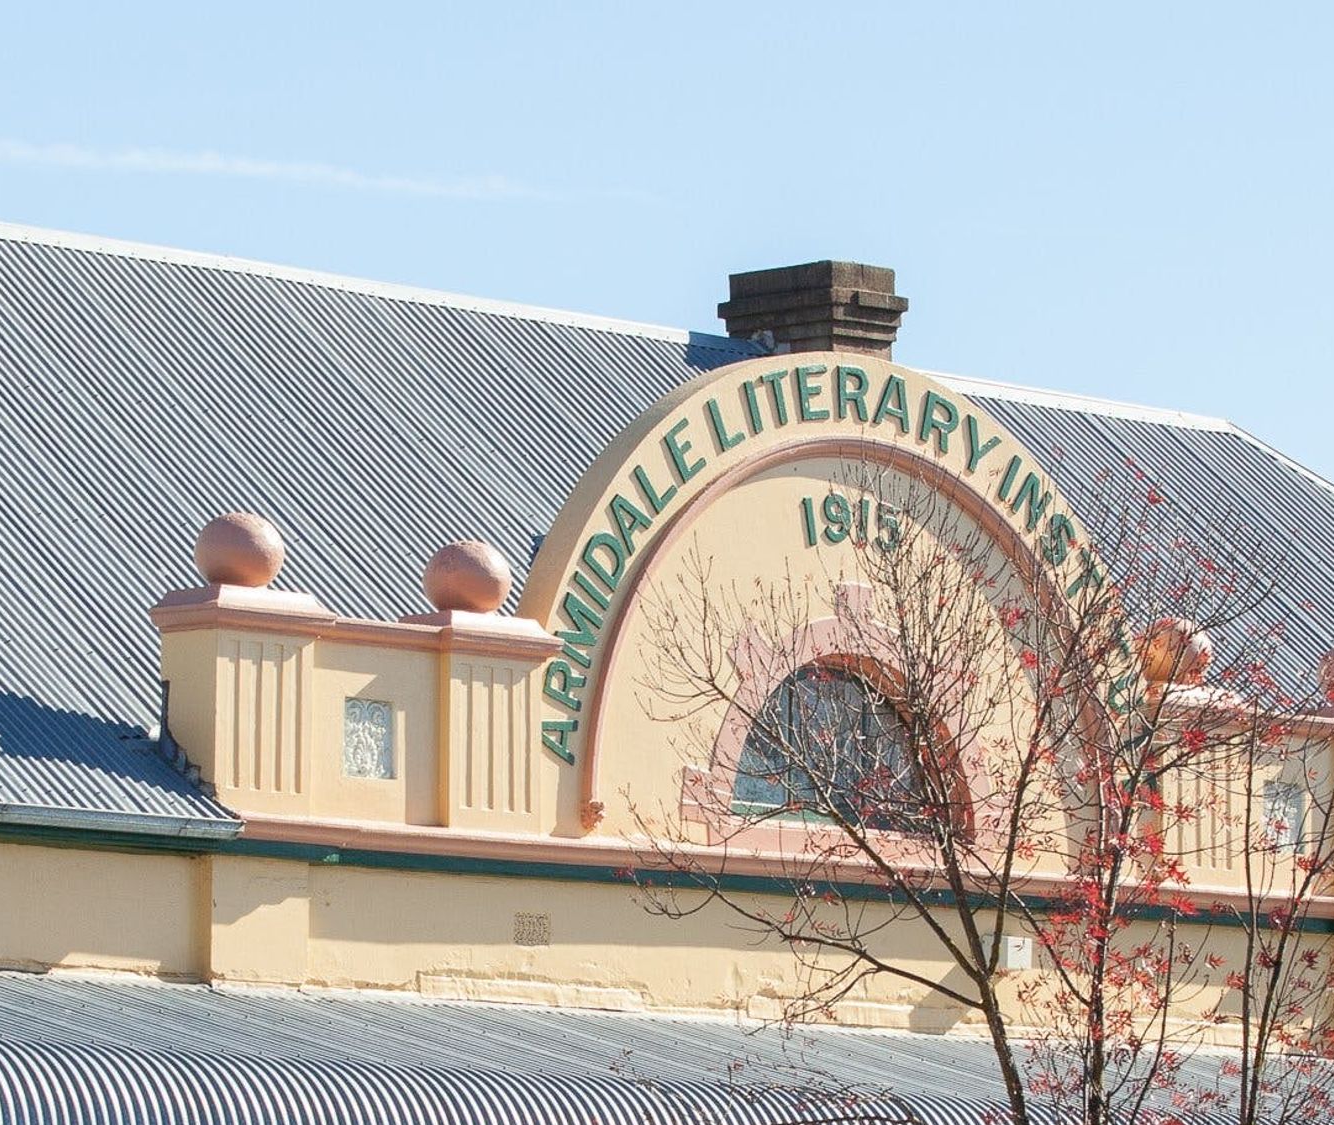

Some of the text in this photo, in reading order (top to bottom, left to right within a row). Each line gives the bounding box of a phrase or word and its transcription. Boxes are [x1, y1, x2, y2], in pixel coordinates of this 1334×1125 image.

[542, 418, 707, 765] ARMIDALE
[702, 364, 1002, 474] LITERARY
[800, 493, 900, 551] 1915
